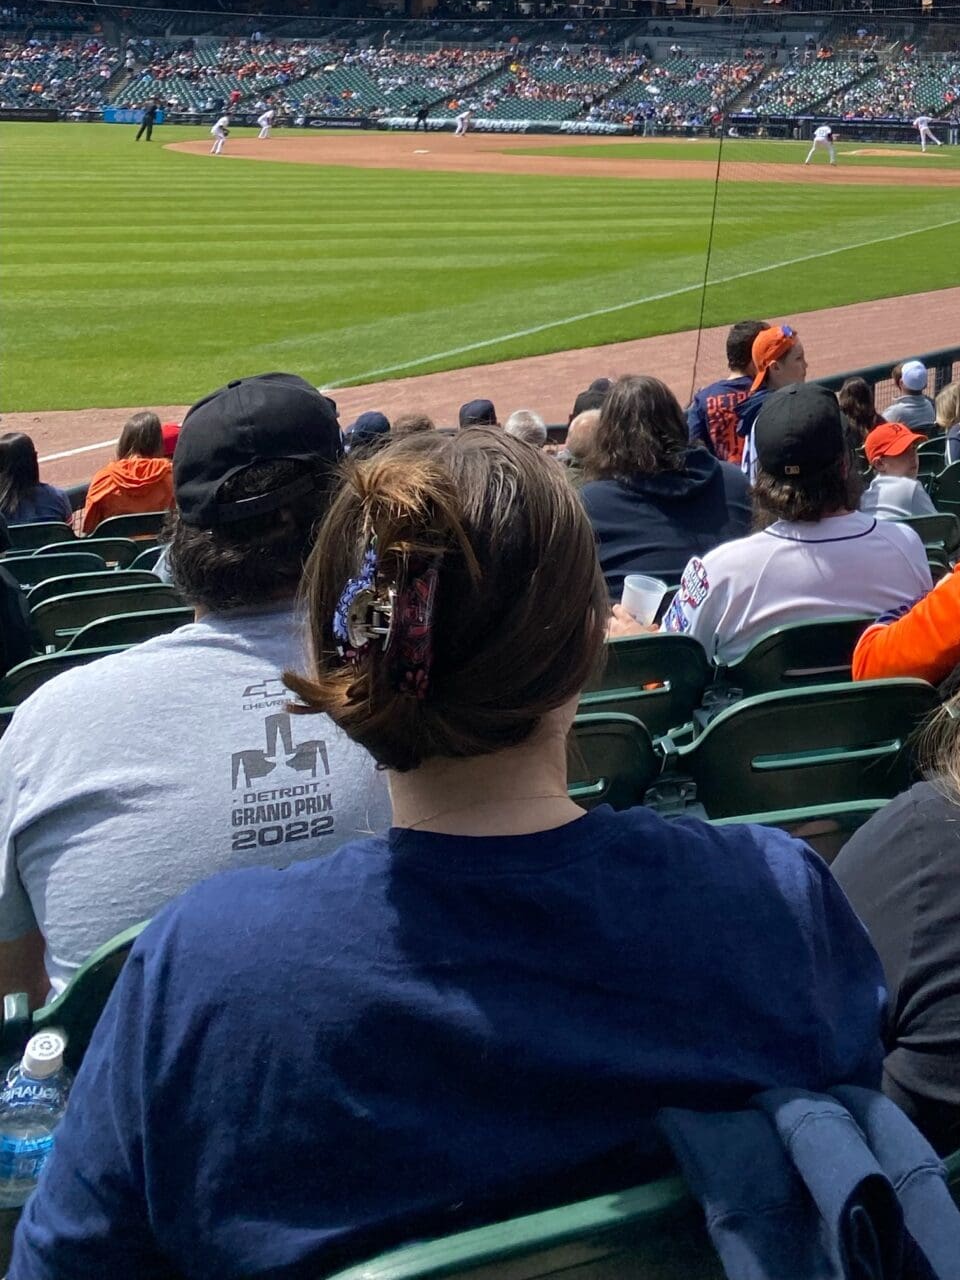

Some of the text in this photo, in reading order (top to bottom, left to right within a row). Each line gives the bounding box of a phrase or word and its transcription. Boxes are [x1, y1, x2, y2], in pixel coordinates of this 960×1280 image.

[706, 391, 752, 415] DETR
[243, 782, 321, 804] DETROIT
[231, 793, 334, 827] GRAND PRIX
[231, 815, 335, 851] 2022
